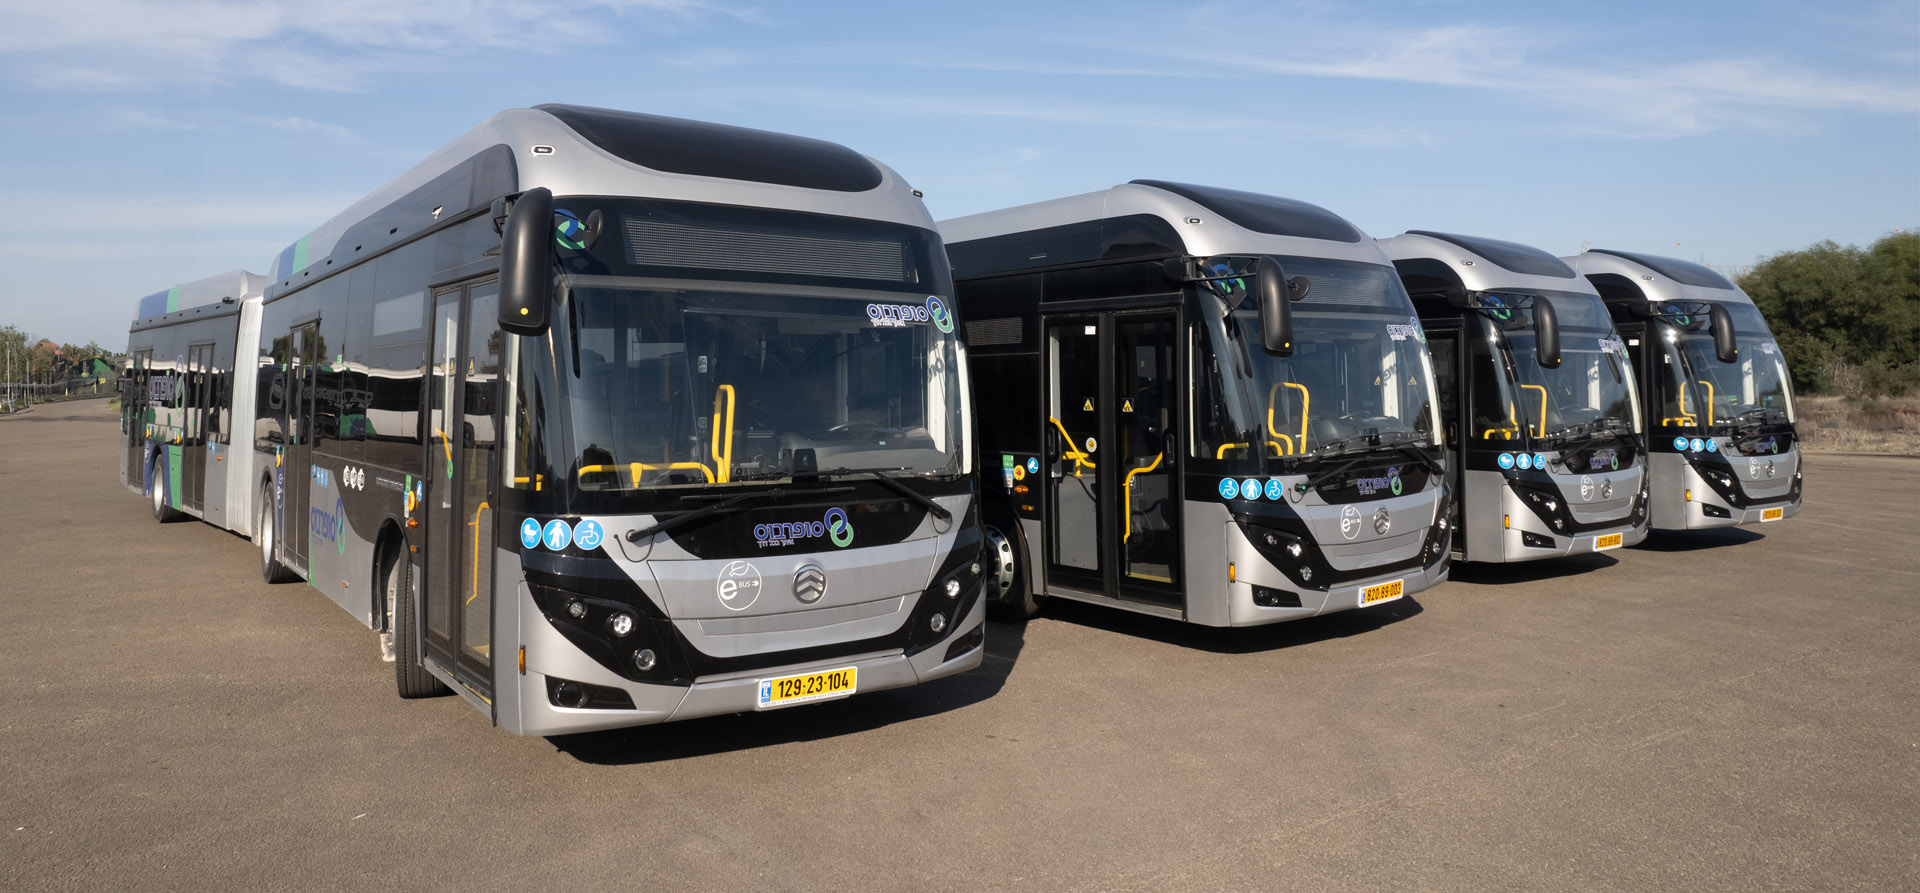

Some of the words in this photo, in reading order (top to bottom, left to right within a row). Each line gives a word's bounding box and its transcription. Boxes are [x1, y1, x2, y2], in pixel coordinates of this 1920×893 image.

[866, 303, 929, 322] סופרבוס
[753, 520, 825, 541] סופרבוס
[719, 579, 738, 600] e
[738, 580, 751, 588] BUS
